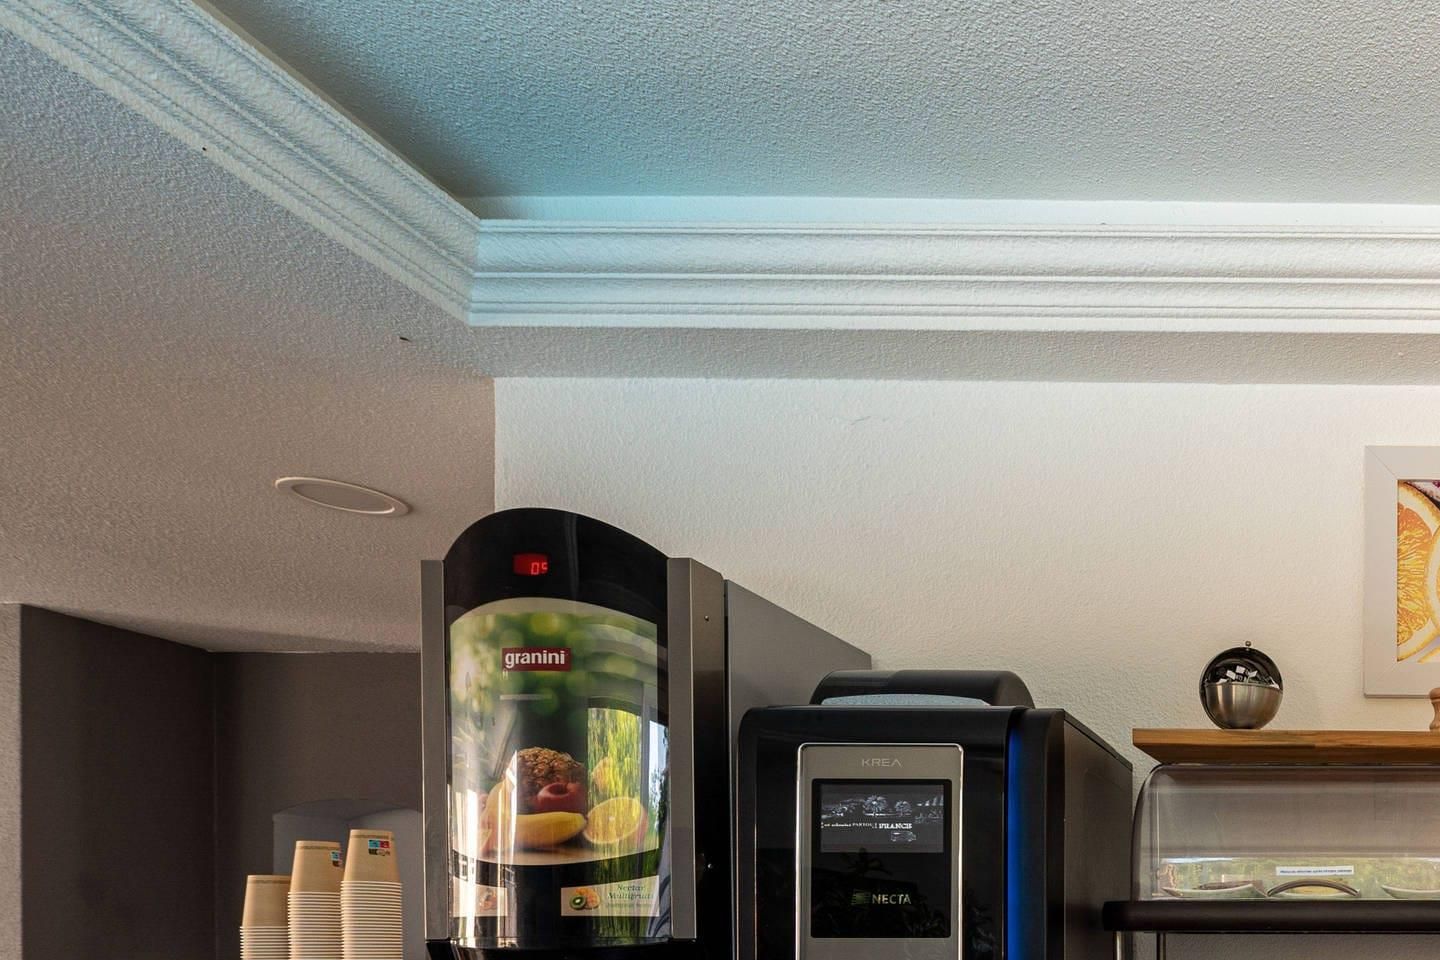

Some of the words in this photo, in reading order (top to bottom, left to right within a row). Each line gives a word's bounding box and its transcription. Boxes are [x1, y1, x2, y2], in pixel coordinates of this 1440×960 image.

[505, 650, 566, 669] granini
[861, 758, 902, 767] KREA
[871, 893, 912, 905] NECTA
